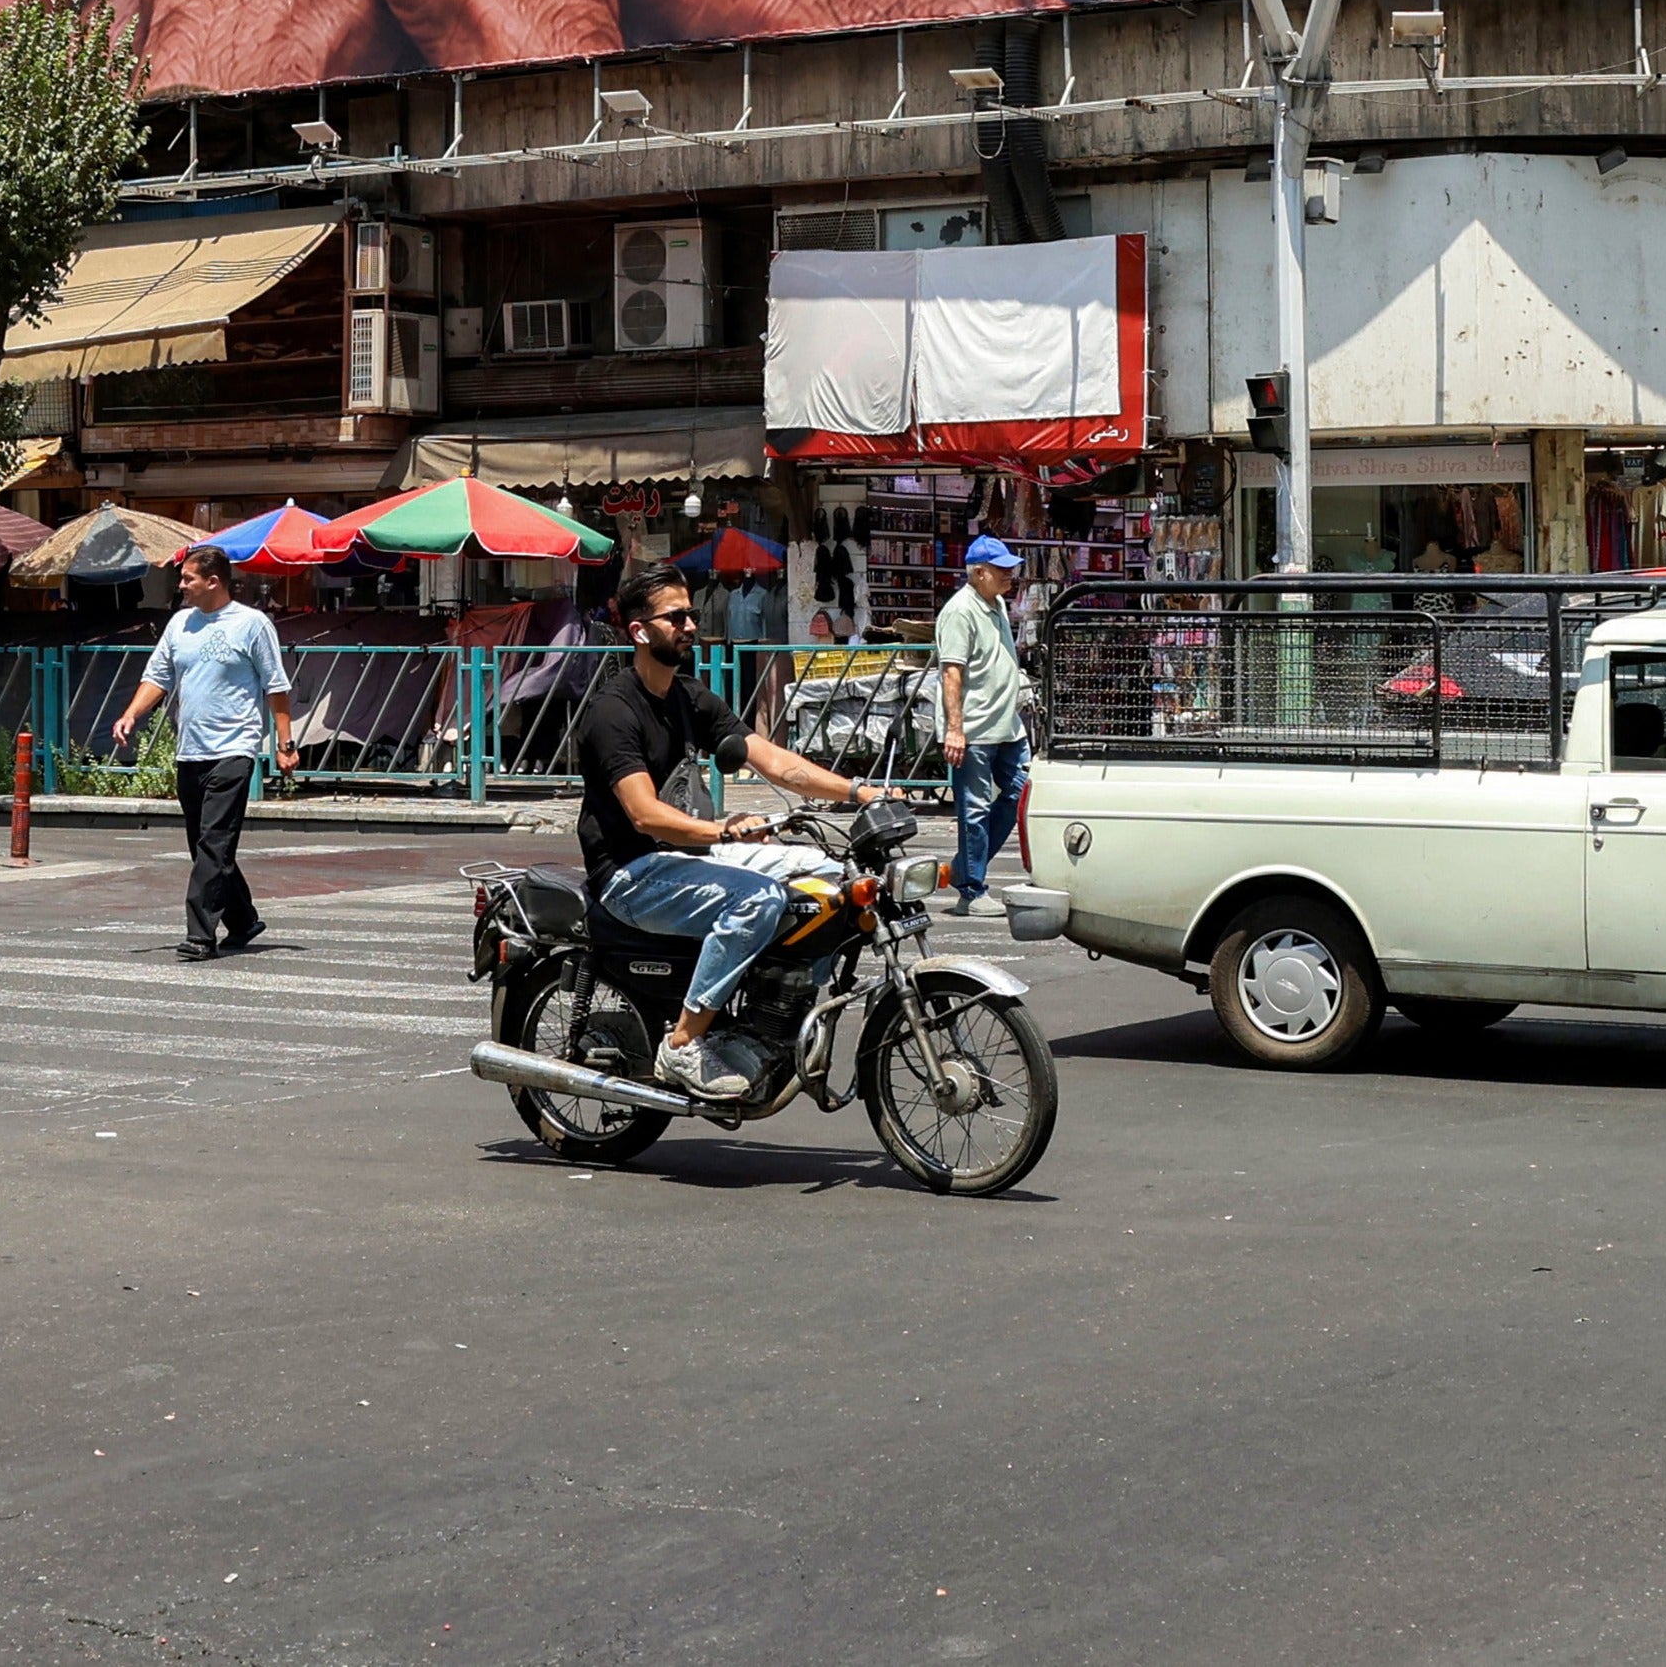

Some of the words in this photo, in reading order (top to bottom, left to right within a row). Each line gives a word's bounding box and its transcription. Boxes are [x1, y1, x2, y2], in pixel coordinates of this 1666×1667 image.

[1088, 424, 1129, 443] رضی
[1357, 458, 1407, 475] Shiva
[1417, 456, 1467, 474] Shiva
[1476, 455, 1527, 473] Shiva
